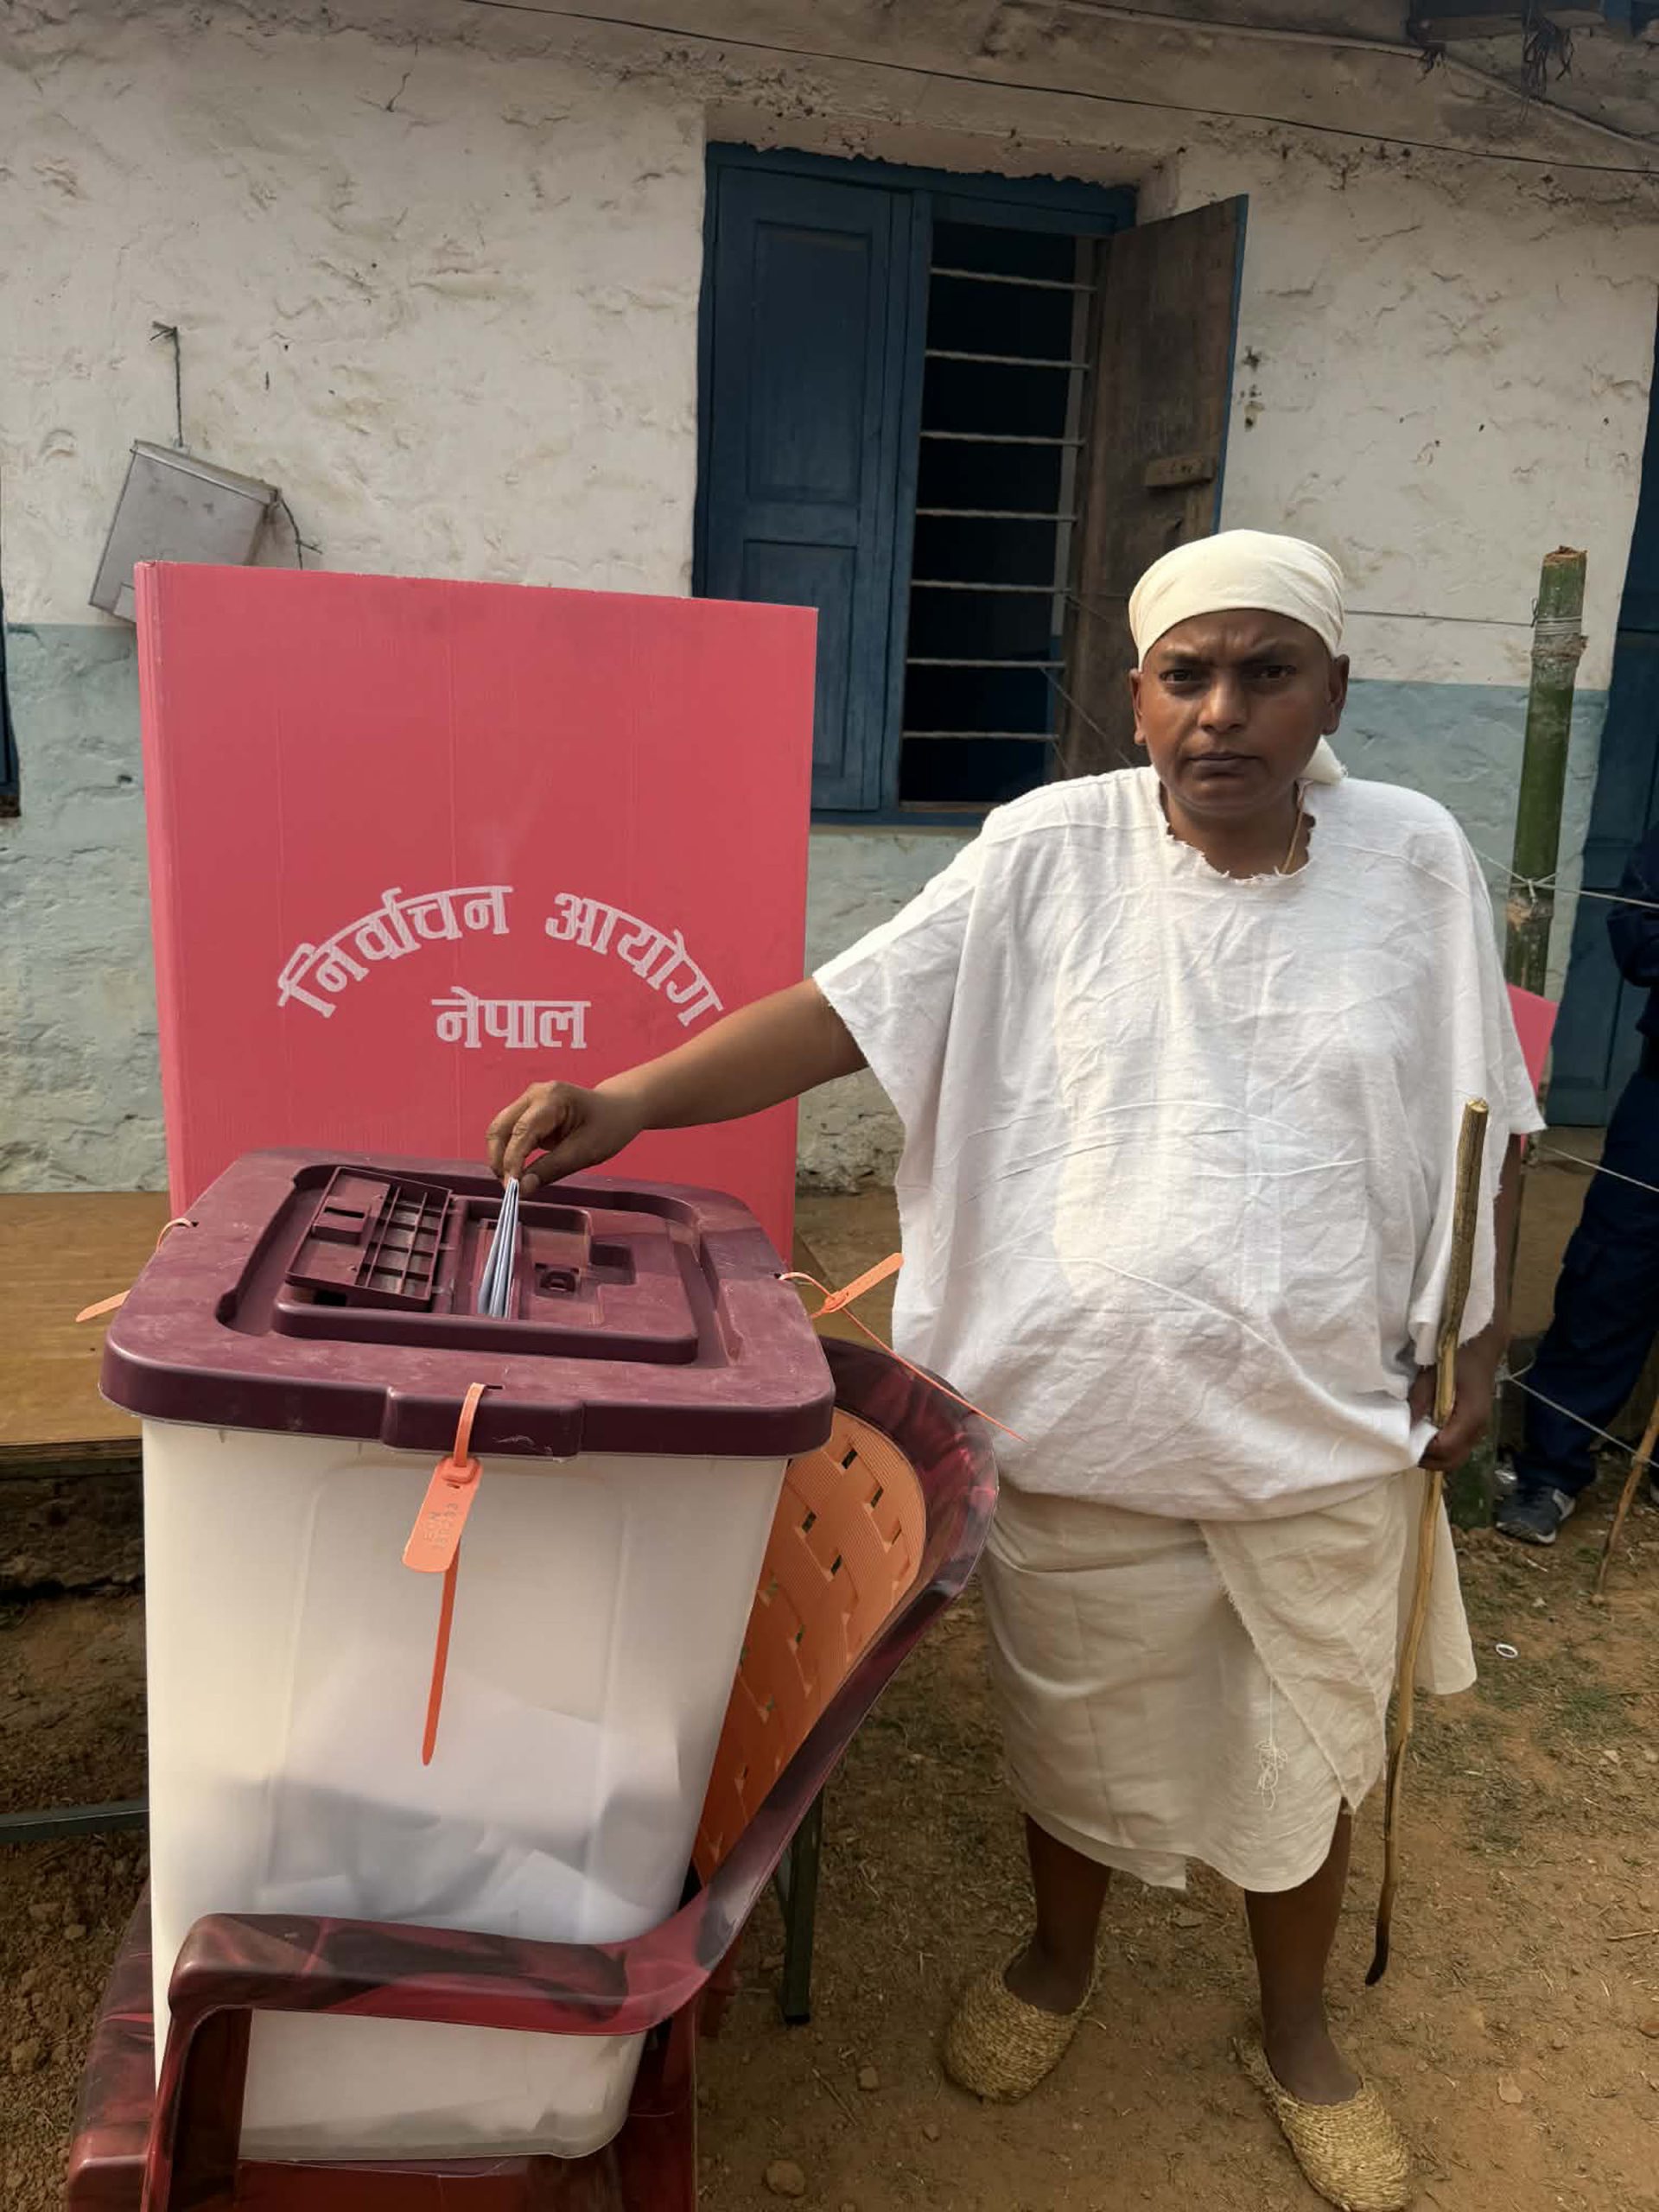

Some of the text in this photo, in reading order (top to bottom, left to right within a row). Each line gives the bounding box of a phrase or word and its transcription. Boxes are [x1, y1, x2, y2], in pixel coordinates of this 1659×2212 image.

[277, 885, 724, 1027] निर्वाचन आयोग
[431, 986, 591, 1048] नेपाल
